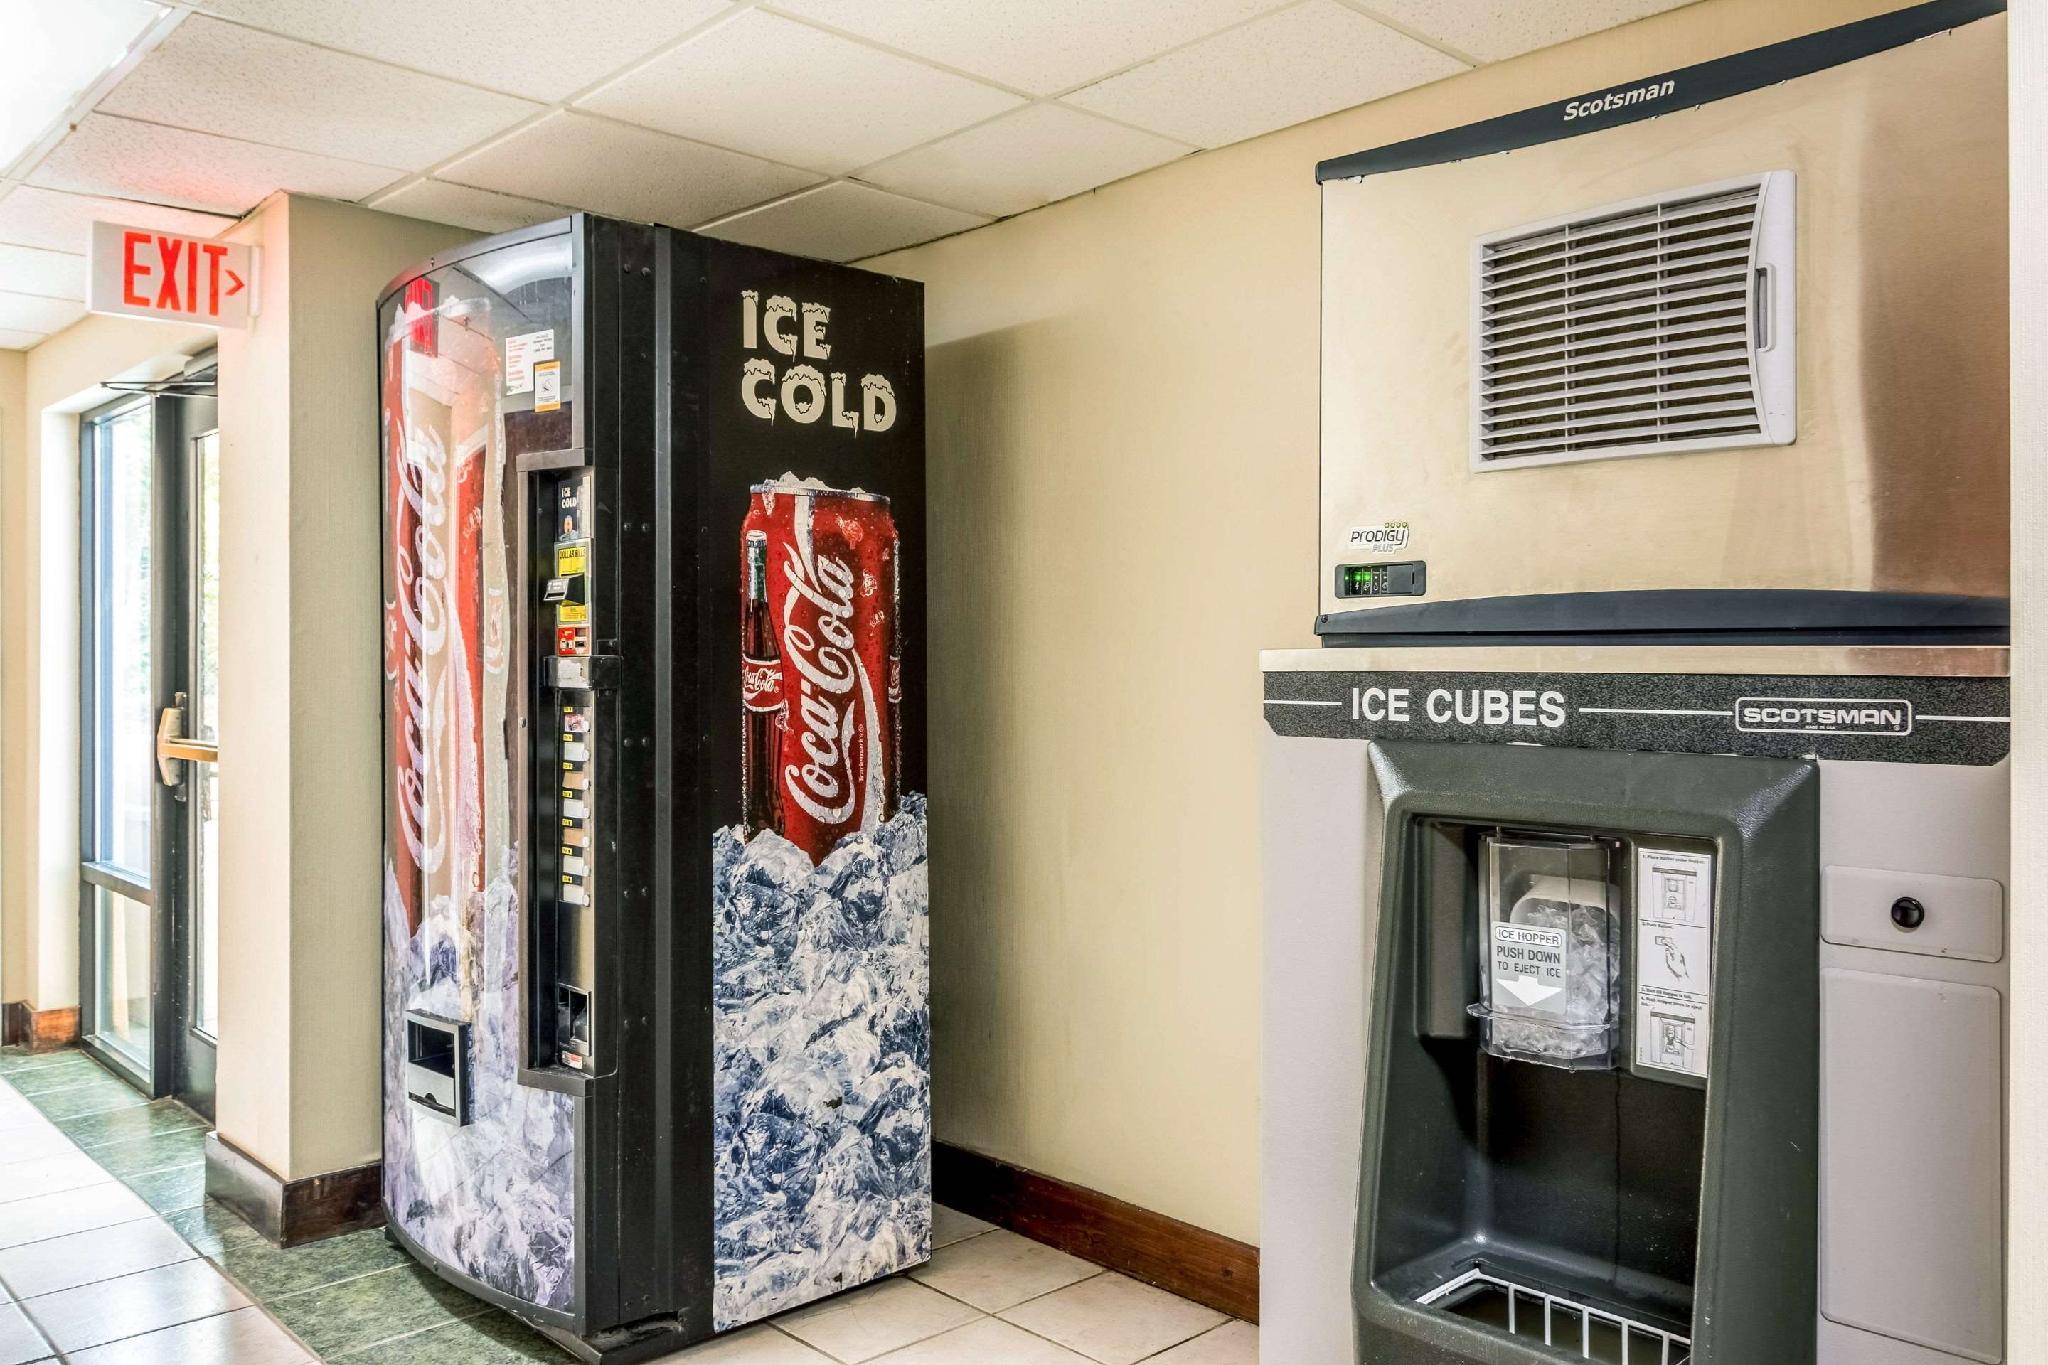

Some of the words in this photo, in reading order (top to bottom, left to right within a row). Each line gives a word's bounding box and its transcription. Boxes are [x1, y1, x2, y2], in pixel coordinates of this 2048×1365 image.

[1563, 79, 1676, 121] Scotsman
[123, 230, 229, 317] EXIT
[741, 289, 832, 362] ICE
[741, 357, 897, 438] COLD
[561, 497, 577, 509] COLD
[783, 541, 857, 825] Coca-Cola
[1352, 687, 1410, 722] ICE
[1426, 688, 1566, 728] CUBES
[1743, 707, 1902, 725] SCOTSMAN
[1496, 945, 1524, 960] PUSH
[1528, 949, 1561, 964] DOWN
[1498, 929, 1514, 939] ICE
[1518, 931, 1560, 945] HOPPER
[1497, 961, 1509, 971] TO
[1514, 963, 1541, 976] EJECT
[1546, 968, 1561, 978] ICE
